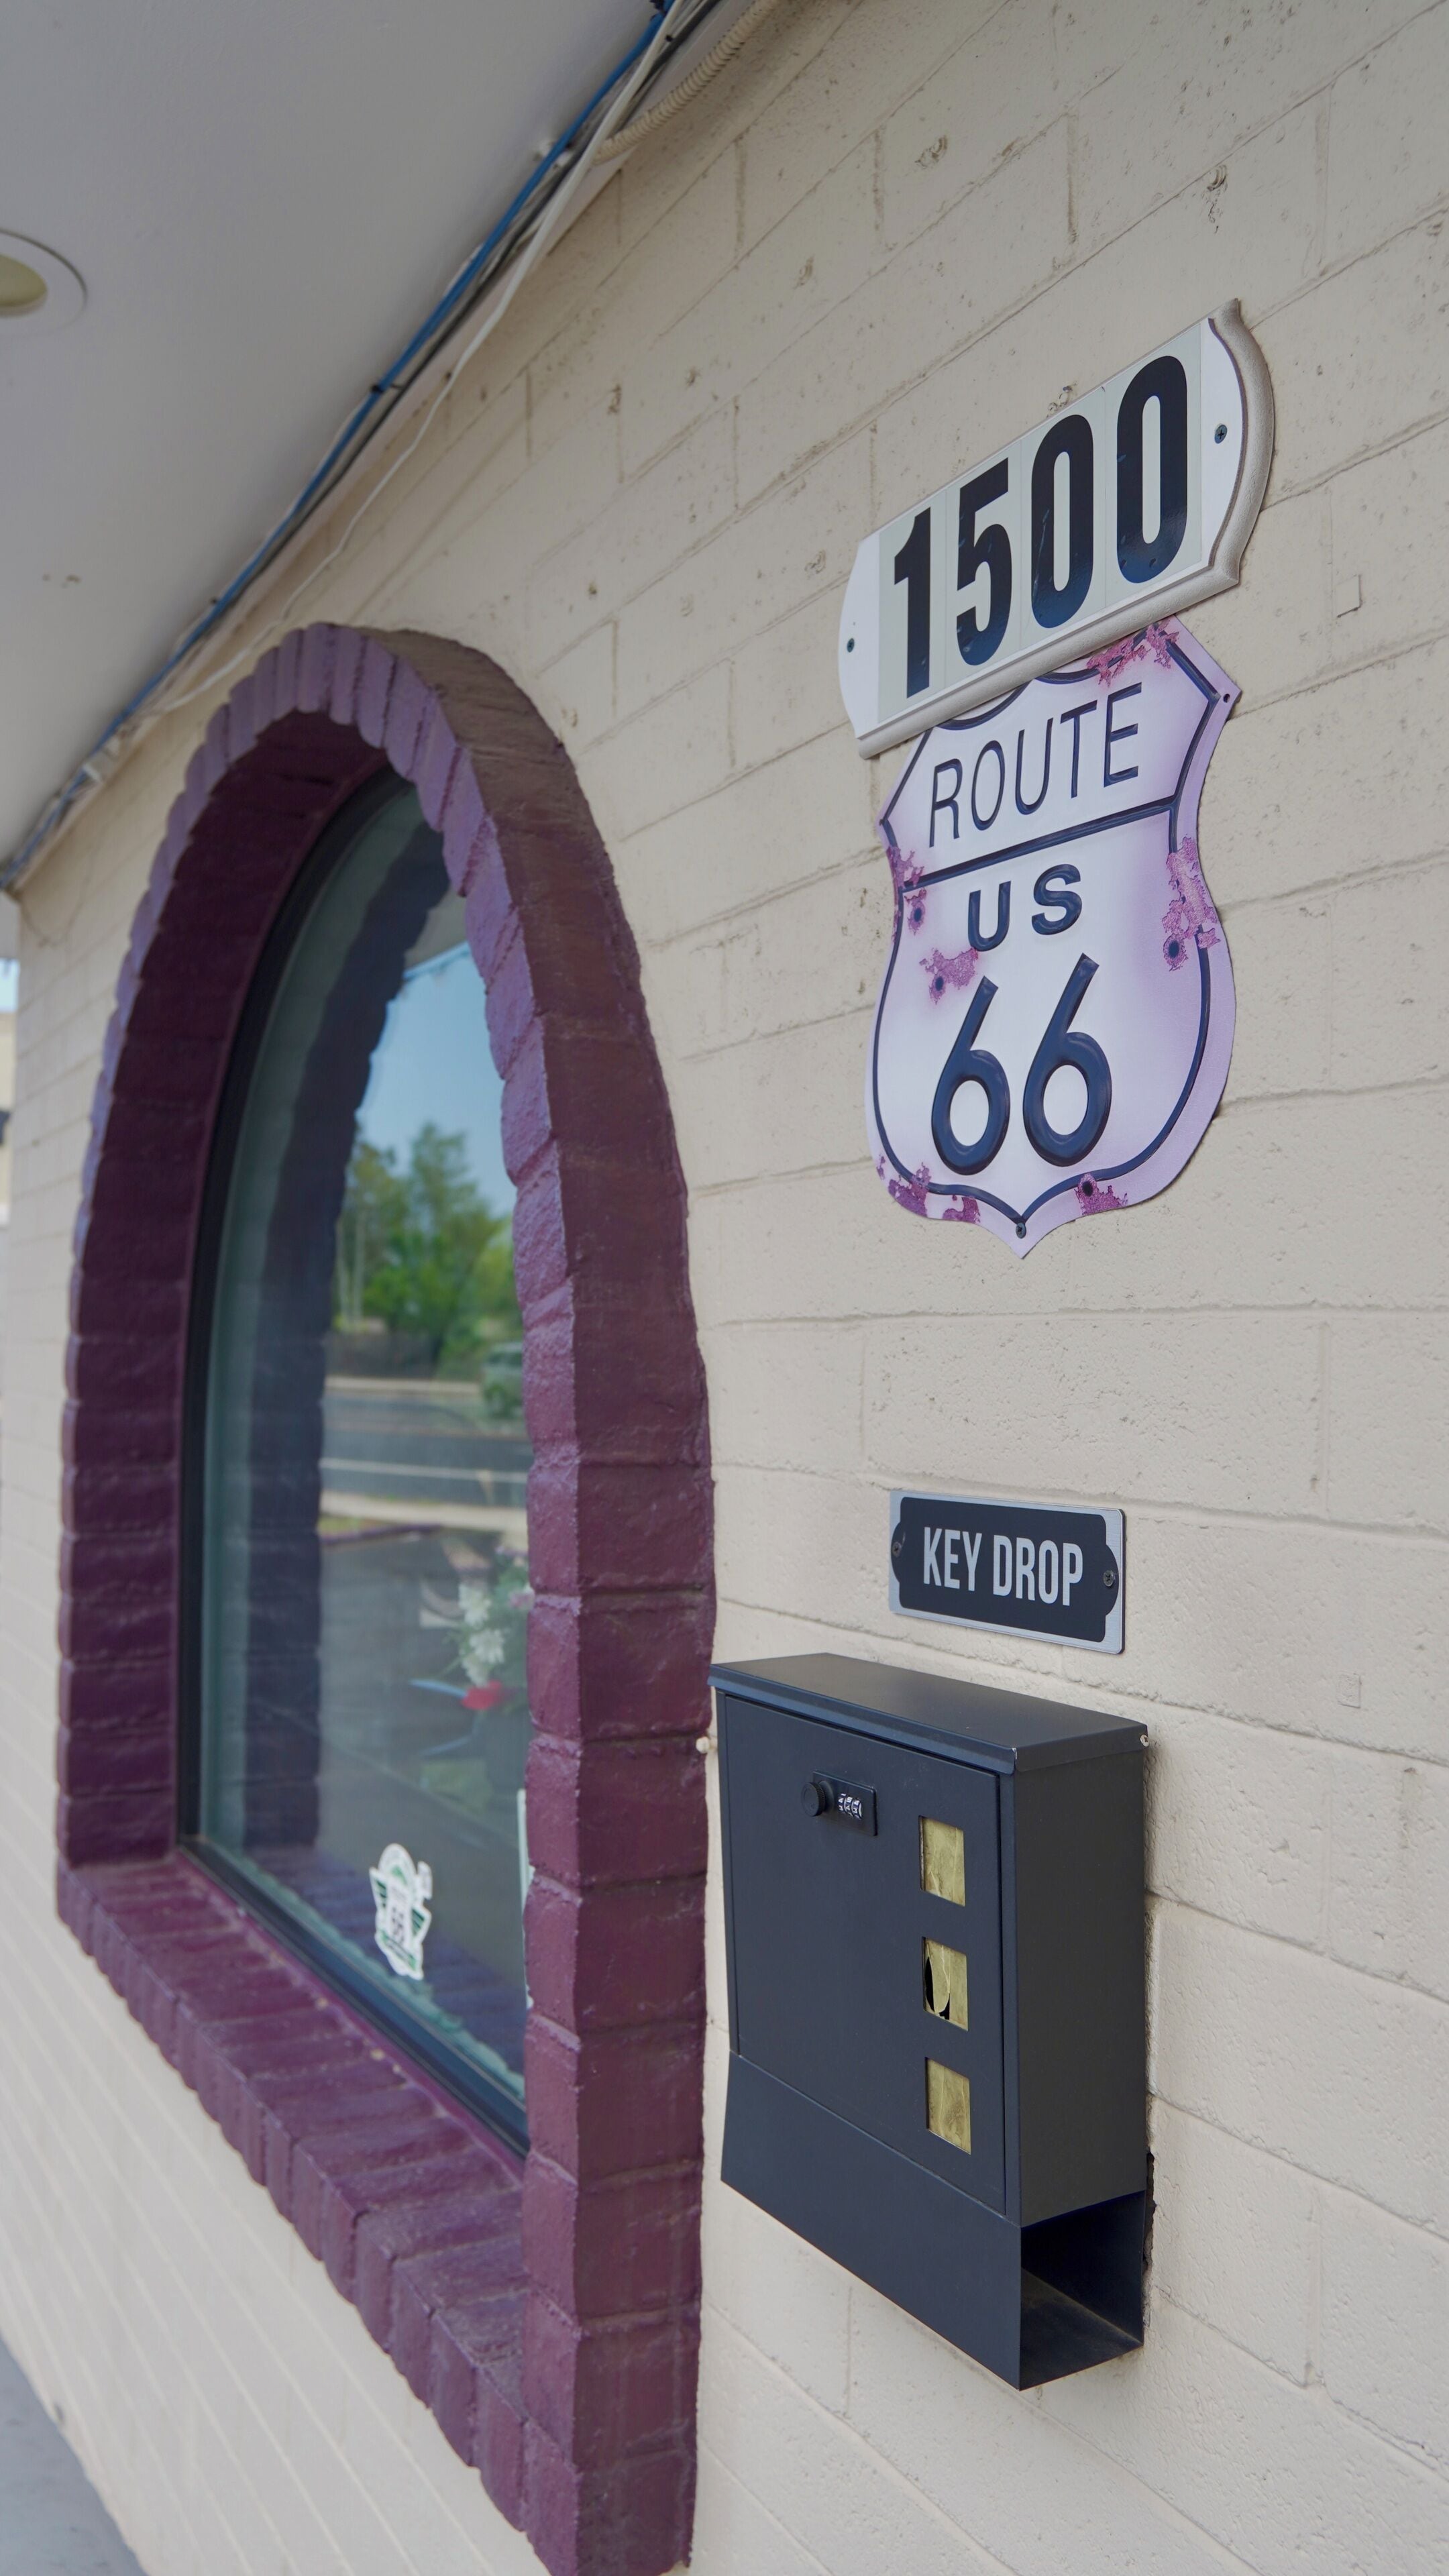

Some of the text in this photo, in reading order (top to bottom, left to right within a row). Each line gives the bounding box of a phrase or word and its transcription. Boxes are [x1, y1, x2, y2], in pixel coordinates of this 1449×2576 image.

[894, 355, 1187, 699] 1500
[928, 682, 1142, 847] ROUTE
[967, 863, 1082, 952] US
[931, 953, 1112, 1176] 66
[923, 1526, 1083, 1607] KEY DROP
